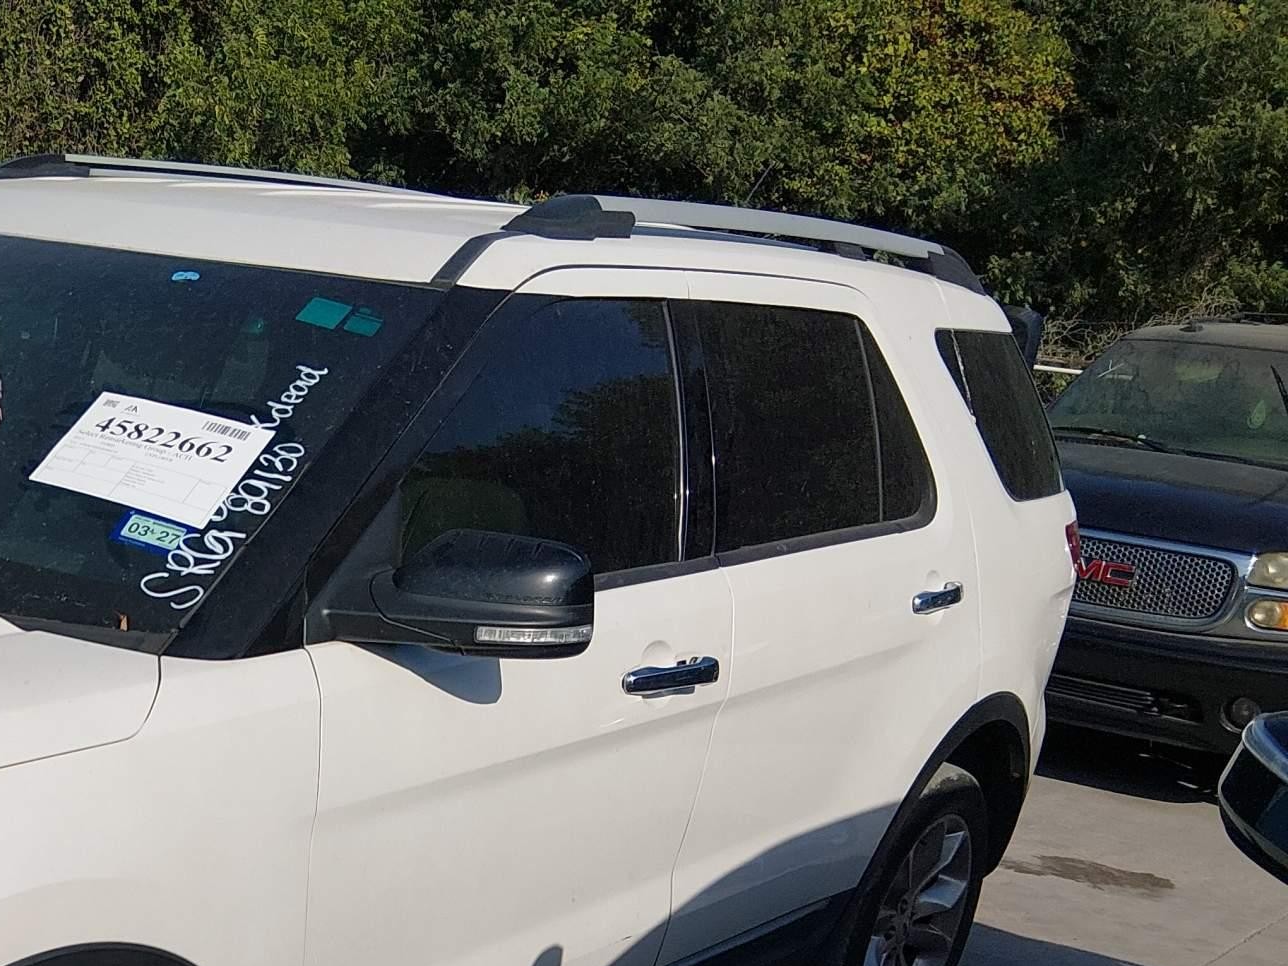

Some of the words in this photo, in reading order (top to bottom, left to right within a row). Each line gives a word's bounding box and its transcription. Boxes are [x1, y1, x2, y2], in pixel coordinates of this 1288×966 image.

[95, 417, 233, 462] 45822662
[128, 522, 150, 537] 03
[156, 530, 181, 545] 27
[1076, 558, 1135, 587] MC
